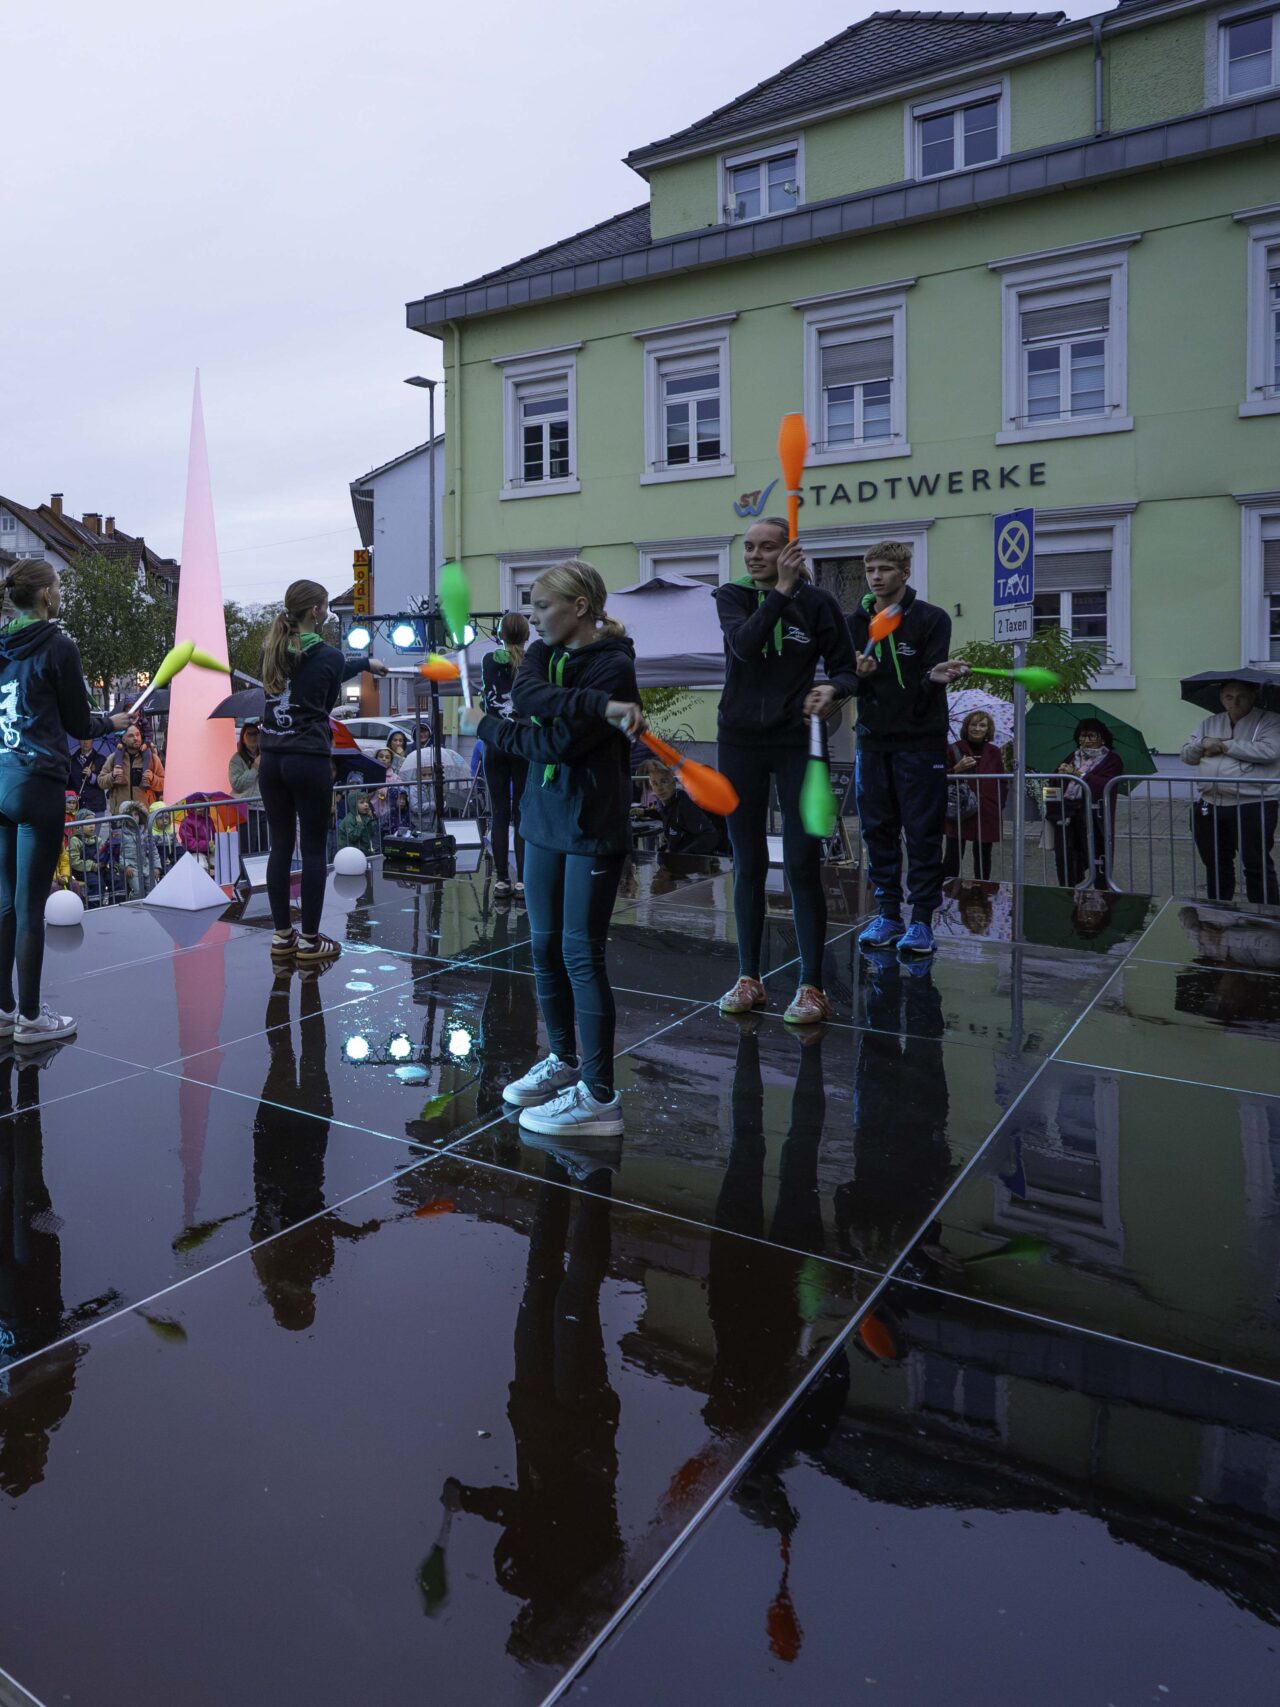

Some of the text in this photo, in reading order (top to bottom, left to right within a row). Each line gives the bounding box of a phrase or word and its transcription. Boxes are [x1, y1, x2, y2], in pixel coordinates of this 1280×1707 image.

[355, 551, 367, 614] Koda
[997, 574, 1029, 599] TAXI
[953, 602, 963, 618] 1
[998, 618, 1028, 634] 2 Taxen
